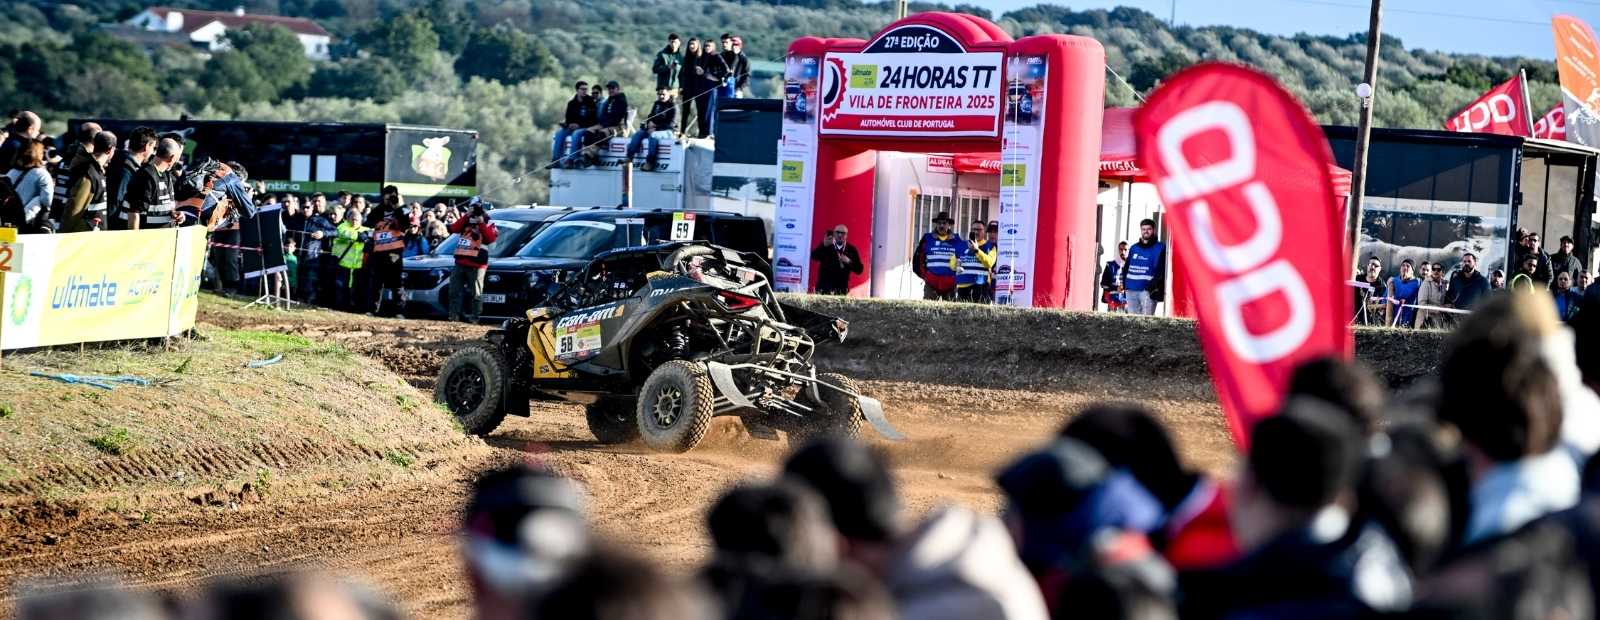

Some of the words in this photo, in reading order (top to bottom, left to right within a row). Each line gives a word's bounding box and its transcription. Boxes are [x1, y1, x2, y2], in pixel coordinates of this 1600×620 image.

[901, 33, 940, 52] EDIÇÃO
[972, 65, 997, 88] TT
[849, 95, 875, 109] VILA
[877, 95, 893, 109] DE
[895, 95, 963, 110] FRONTEIRA
[966, 95, 995, 109] 2025
[860, 117, 897, 128] AUTOMÓVEL
[897, 119, 913, 128] CLUB
[913, 119, 922, 128] DE
[922, 119, 955, 128] PORTUGAL
[51, 274, 118, 310] ultimate
[560, 335, 573, 353] 58
